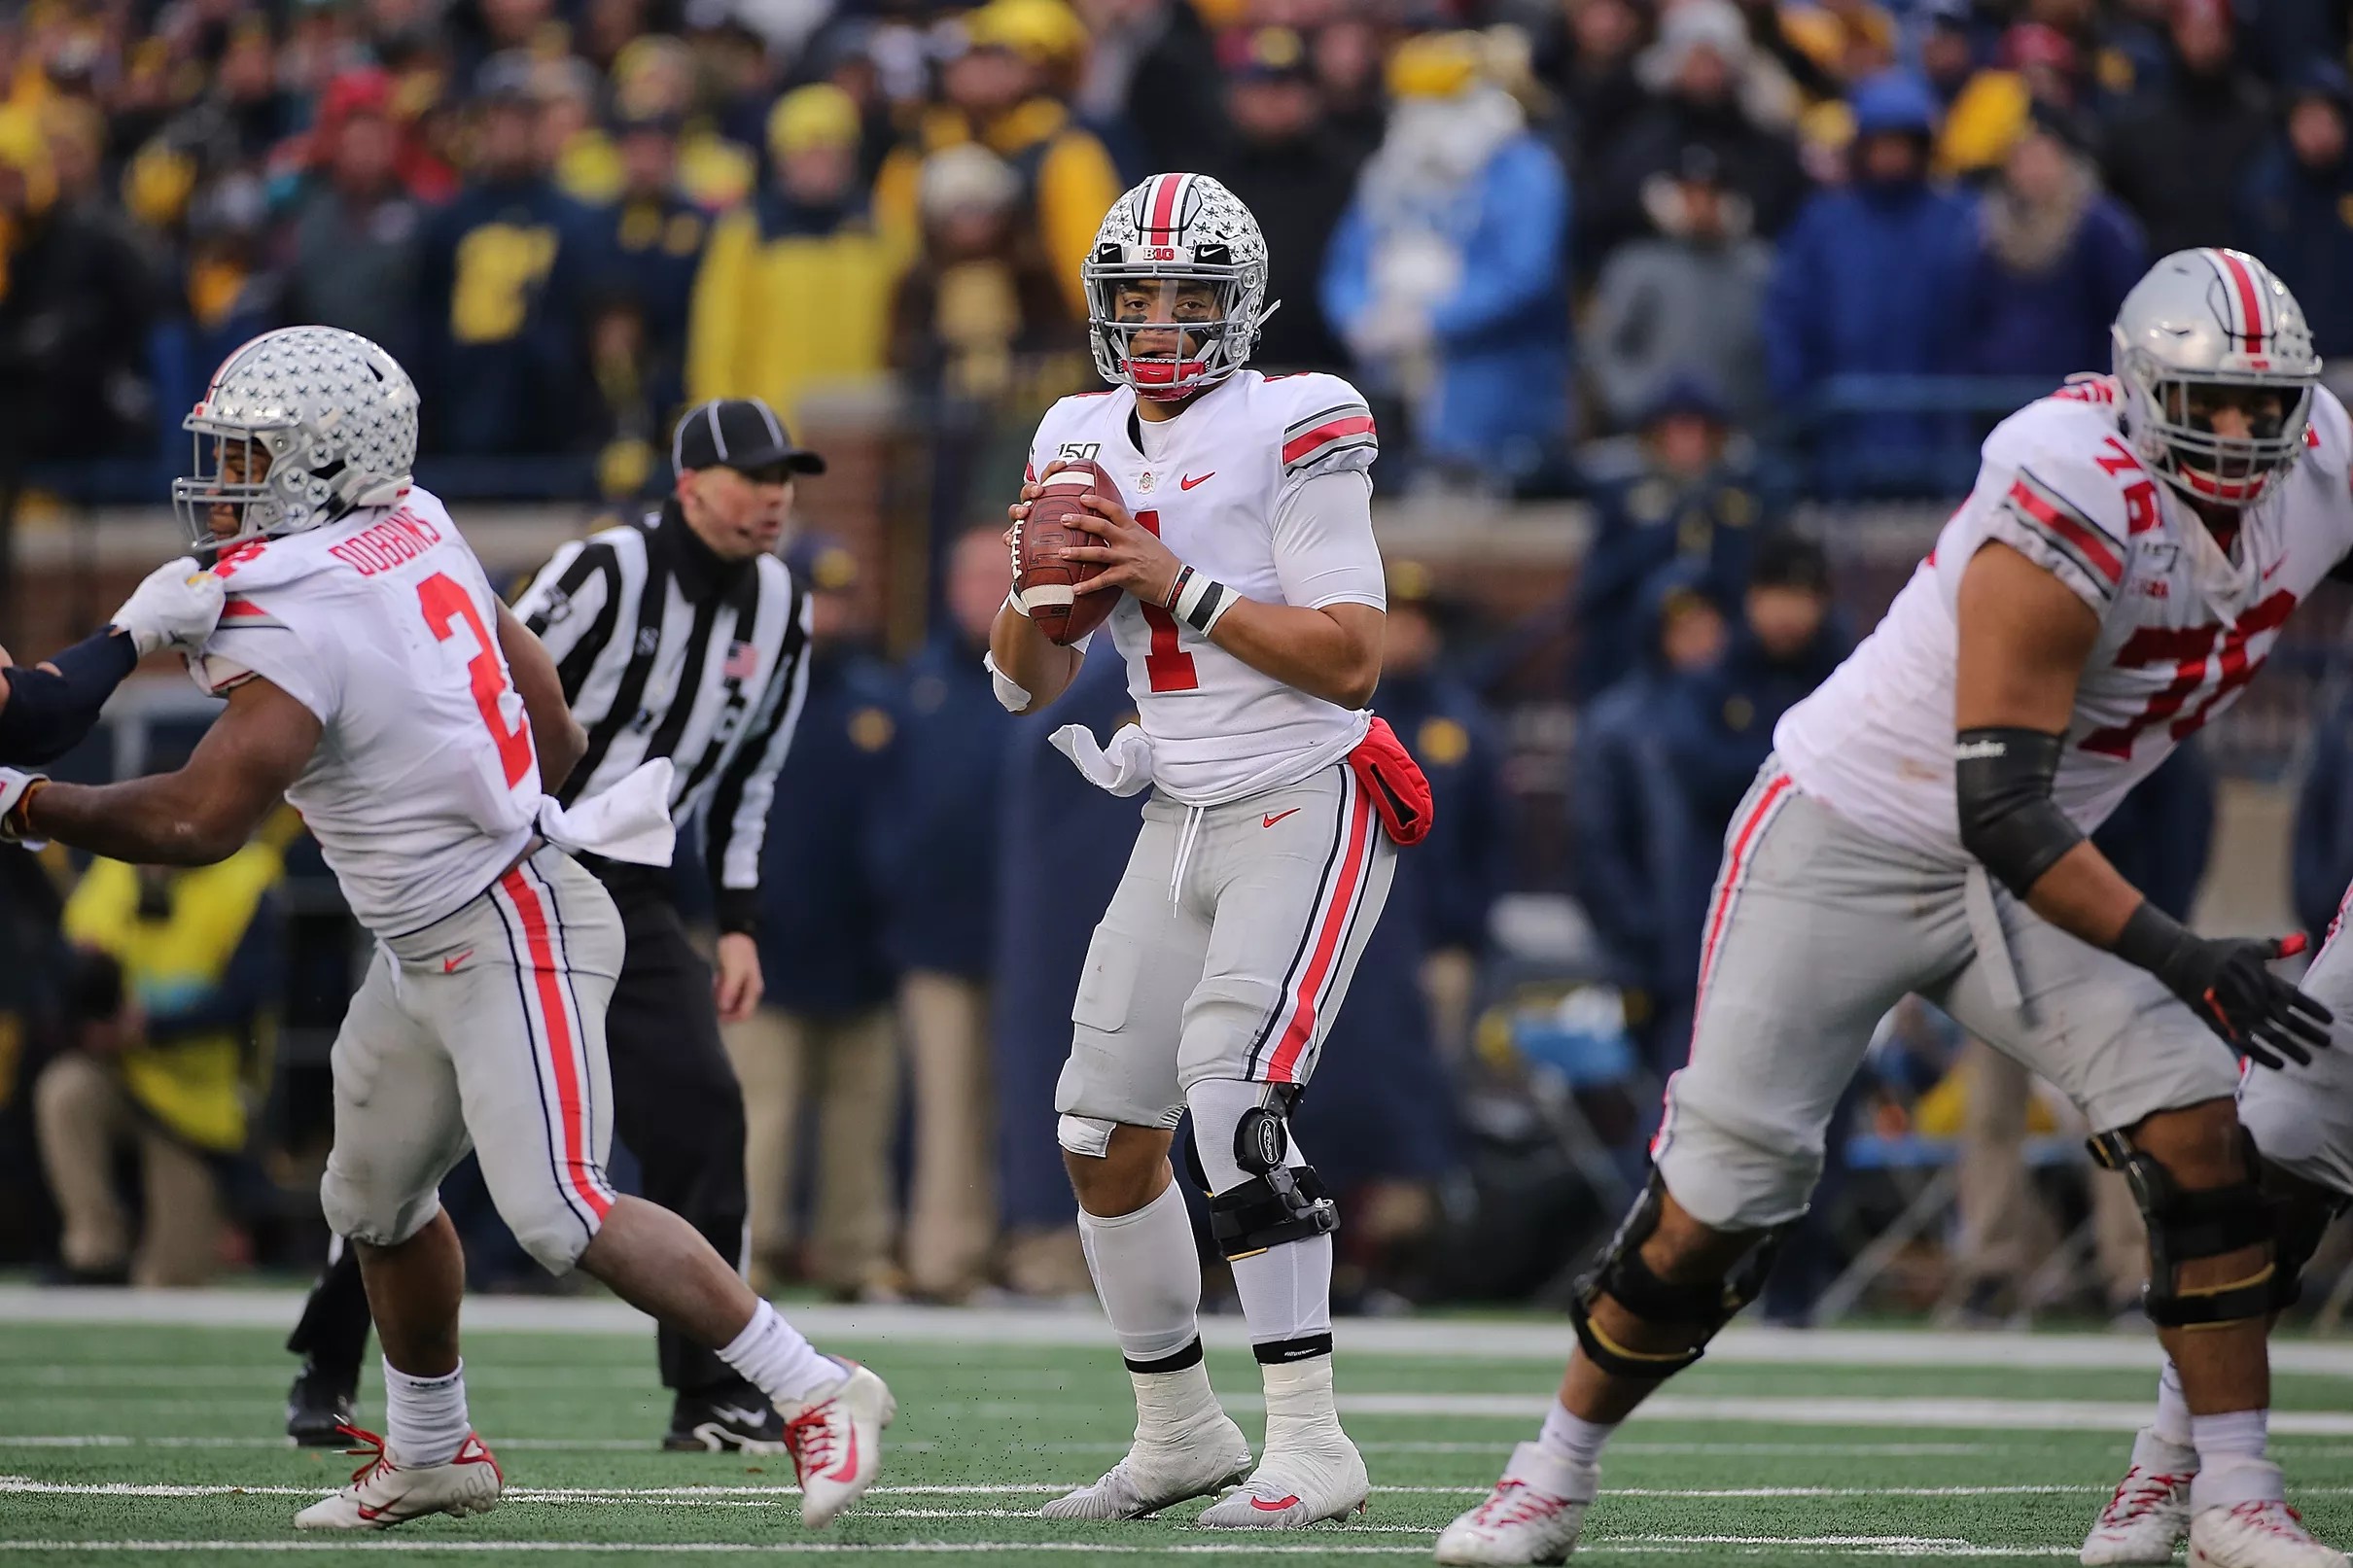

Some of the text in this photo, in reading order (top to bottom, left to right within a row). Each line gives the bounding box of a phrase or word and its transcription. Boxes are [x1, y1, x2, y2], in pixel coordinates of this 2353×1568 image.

[328, 506, 441, 575] DOBBINS
[1134, 509, 1200, 693] 1
[416, 571, 533, 791] 2
[2077, 588, 2297, 762] 76
